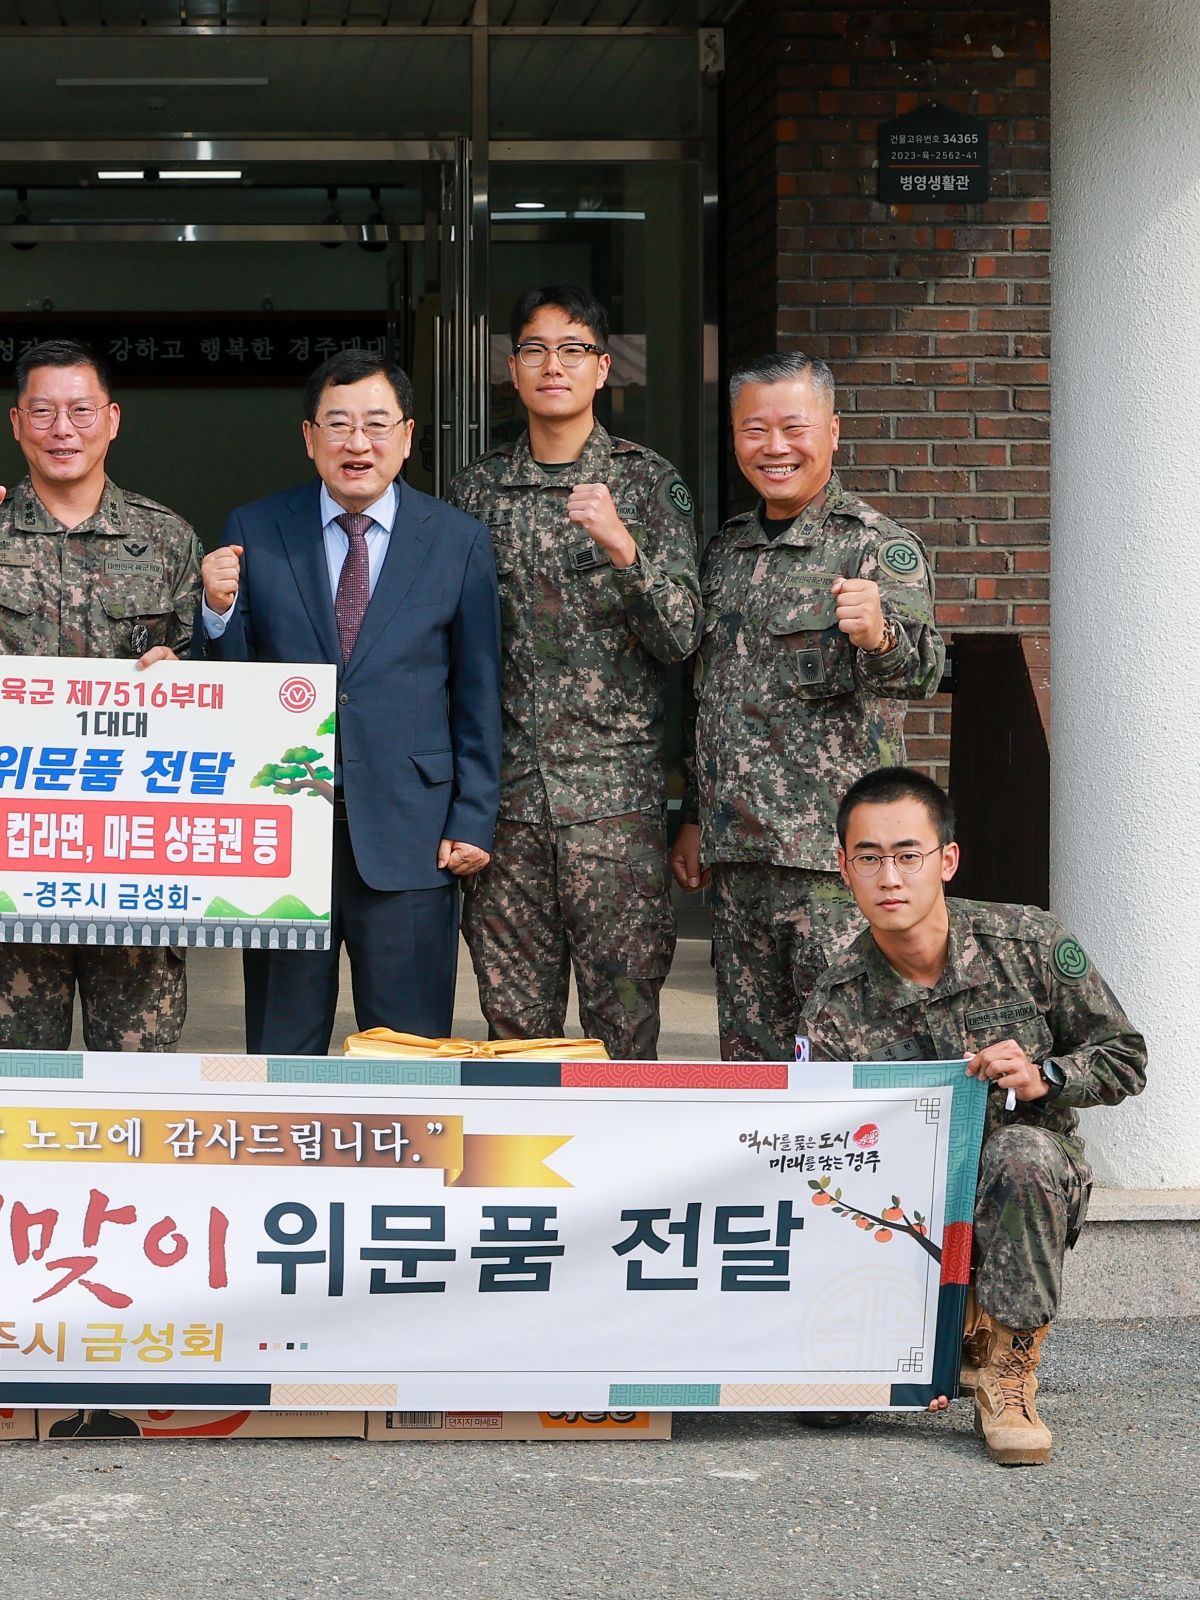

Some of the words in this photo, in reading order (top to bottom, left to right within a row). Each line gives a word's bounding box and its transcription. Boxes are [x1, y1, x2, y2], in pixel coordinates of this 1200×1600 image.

[890, 134, 940, 145] 건물고유번호
[942, 133, 979, 144] 34365
[891, 151, 978, 160] 2023-육-2562-41
[900, 175, 970, 191] 병영생활관
[108, 336, 185, 362] 강하고
[199, 336, 274, 362] 행복한
[107, 562, 134, 571] 대한민국
[0, 677, 55, 707] 육군
[65, 679, 225, 710] 제7516부대
[75, 710, 149, 739] 1대대
[140, 750, 236, 795] 전달
[6, 811, 93, 864] 컵라면,
[103, 814, 156, 861] 마트
[164, 816, 243, 864] 상품권
[252, 818, 279, 866] 등
[23, 880, 108, 911] -경주시
[118, 883, 202, 912] 금성회-
[968, 1012, 999, 1026] 대한민국
[1000, 1009, 1014, 1021] 육군
[1015, 1005, 1035, 1018] ROKA
[22, 1114, 143, 1159] 노고에
[163, 1117, 444, 1164] 감사드립니다.”
[738, 1129, 792, 1154] 역사를
[794, 1135, 816, 1152] 품은
[818, 1131, 850, 1149] 도시
[769, 1153, 816, 1173] 미래를
[818, 1155, 844, 1172] 담는
[844, 1150, 881, 1173] 경주
[256, 1201, 566, 1297] 위문품
[611, 1200, 805, 1293] 전달
[80, 1321, 225, 1364] 금성회
[448, 1418, 473, 1428] 던지지
[474, 1417, 499, 1427] 마세요
